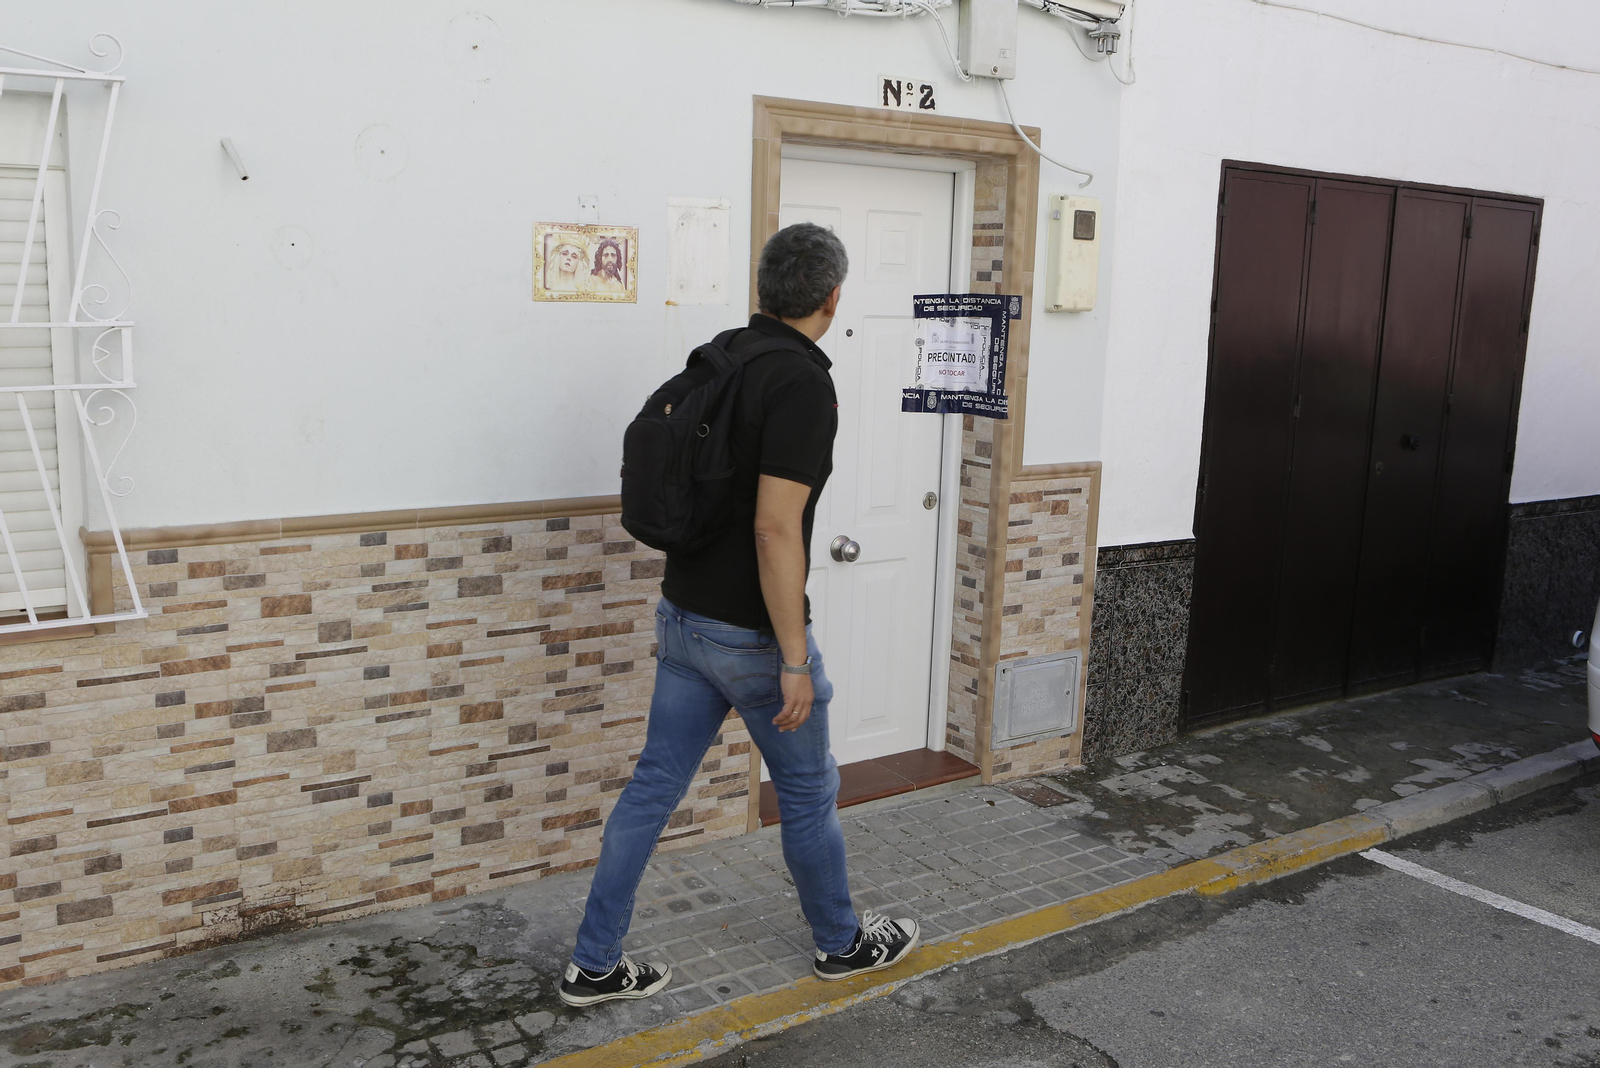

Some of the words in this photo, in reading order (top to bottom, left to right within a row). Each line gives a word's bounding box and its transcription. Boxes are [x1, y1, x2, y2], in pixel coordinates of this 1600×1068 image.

[919, 84, 936, 110] 2
[962, 297, 1002, 305] DISTANCIA
[993, 337, 1000, 352] DE
[998, 310, 1007, 368] MANTENGA
[927, 352, 977, 364] PRECINTADO
[947, 369, 965, 377] TOCAR
[997, 371, 1003, 385] LA
[940, 394, 983, 402] MANTENGA
